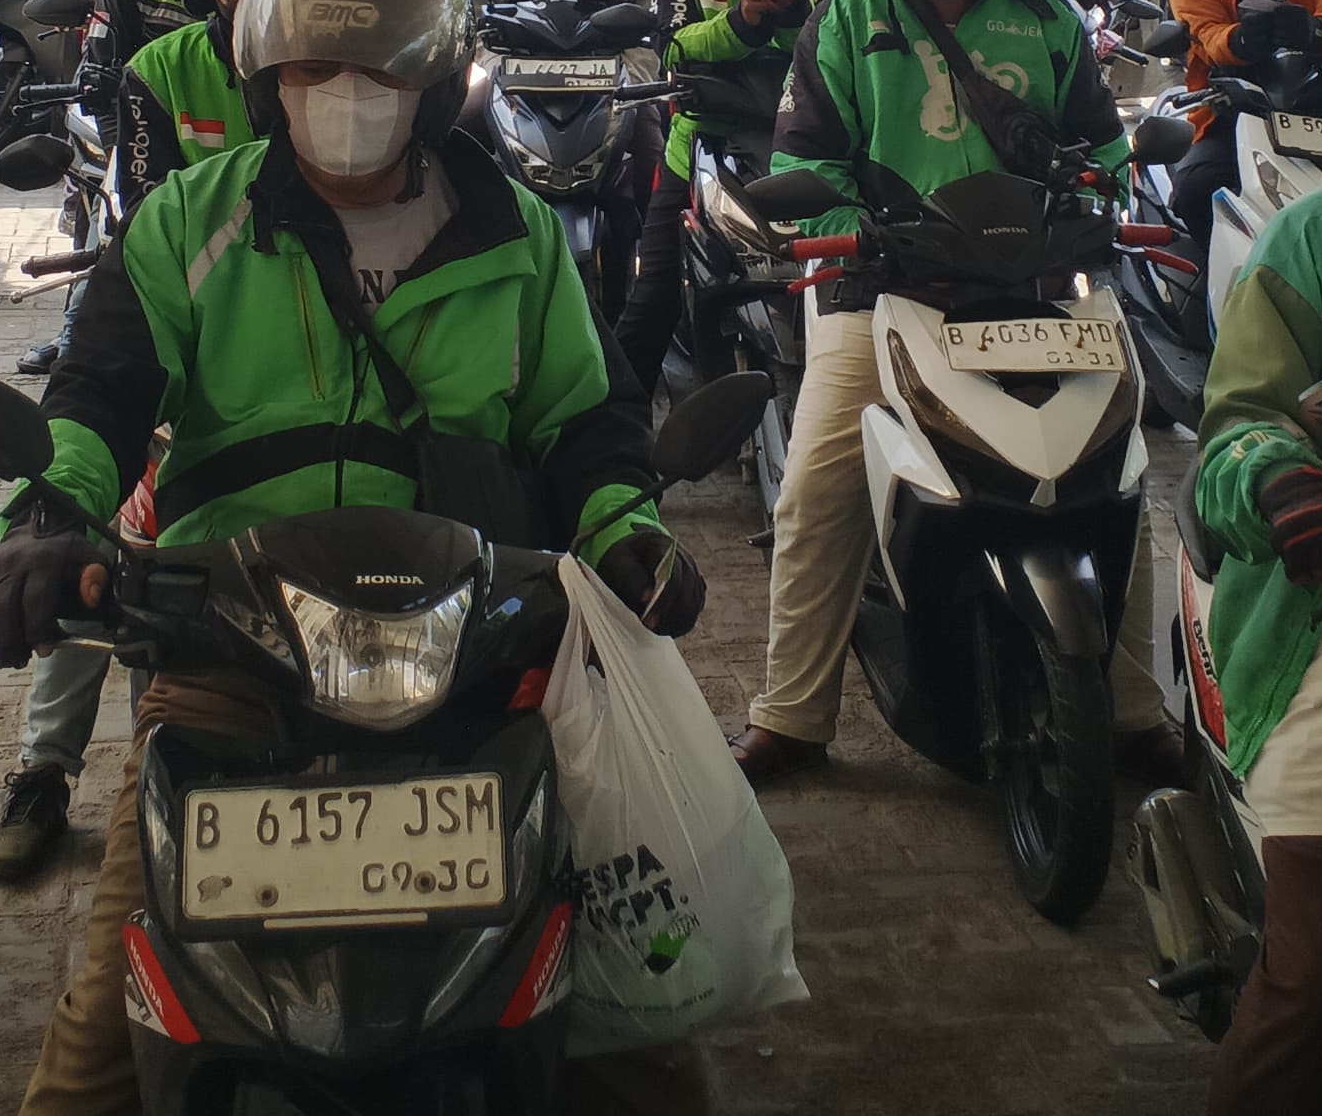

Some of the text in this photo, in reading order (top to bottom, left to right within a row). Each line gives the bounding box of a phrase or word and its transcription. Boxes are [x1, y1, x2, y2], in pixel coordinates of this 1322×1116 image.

[1279, 114, 1292, 129] B
[982, 226, 1029, 236] HONDA
[947, 326, 964, 346] B
[356, 574, 425, 585] HONDA
[196, 781, 495, 850] B 6157 JSM
[129, 934, 166, 1020] HONDA
